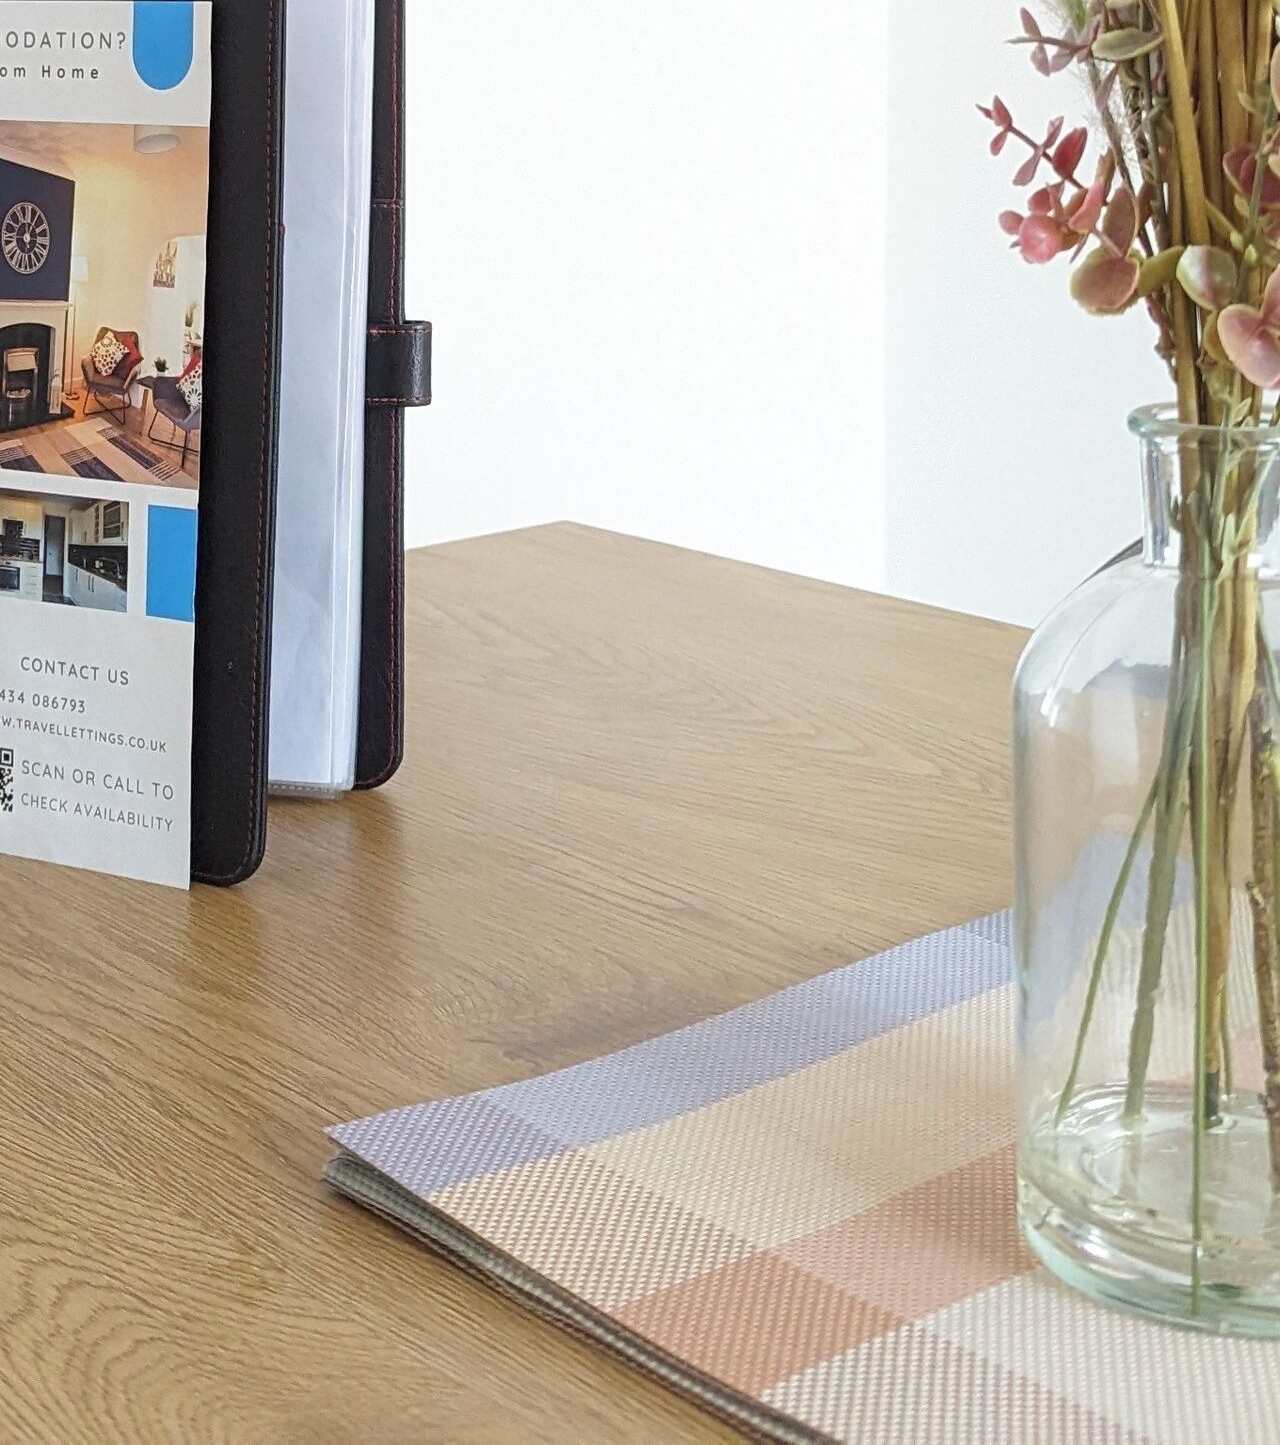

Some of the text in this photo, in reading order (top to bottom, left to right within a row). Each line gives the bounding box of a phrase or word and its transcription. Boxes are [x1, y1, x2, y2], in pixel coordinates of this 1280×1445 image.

[42, 64, 100, 79] Home
[21, 656, 129, 685] CONTACT US
[32, 694, 85, 713] 086793
[21, 760, 173, 800] SCAN OR CALL TO
[21, 793, 173, 832] CHECK AVAILABILITY
